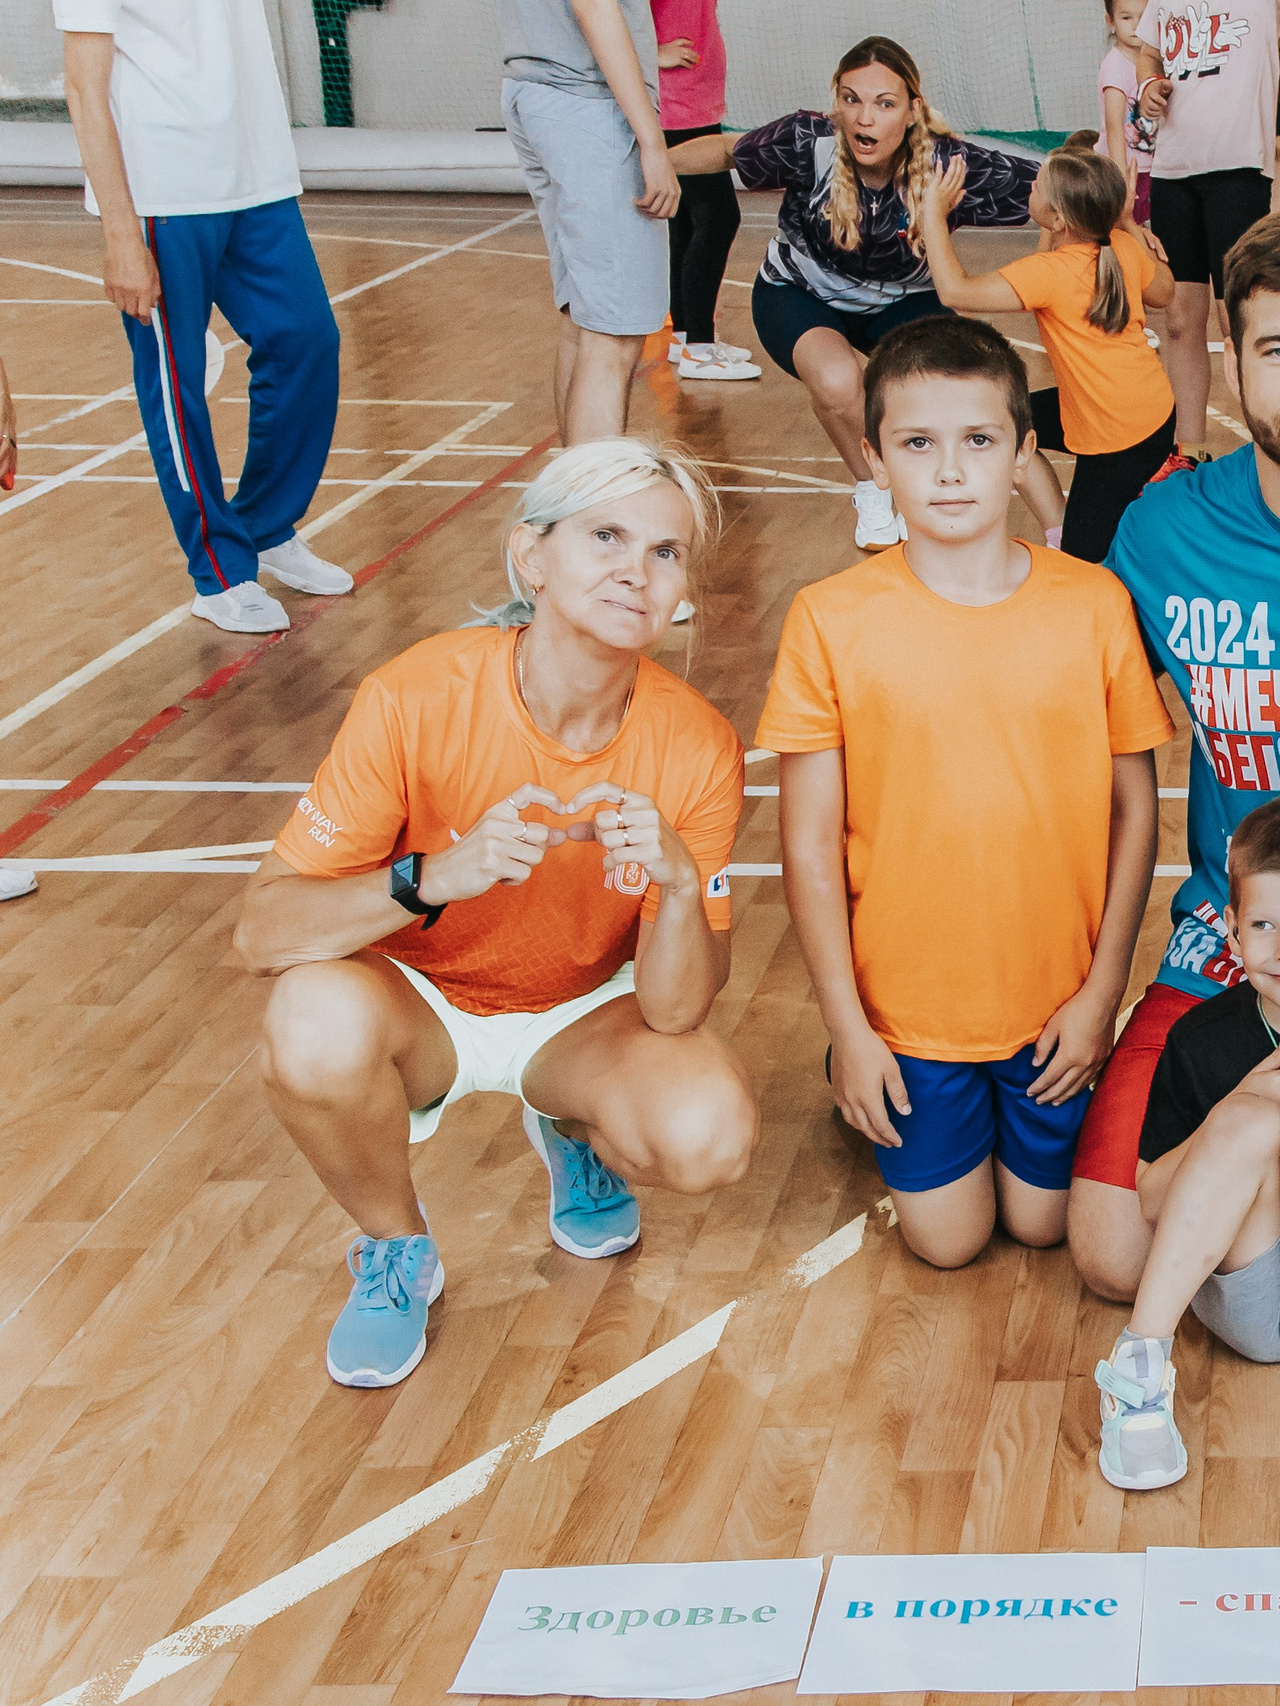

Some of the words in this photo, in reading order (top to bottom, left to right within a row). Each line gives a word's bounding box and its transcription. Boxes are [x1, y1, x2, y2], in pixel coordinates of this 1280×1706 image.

[1165, 595, 1275, 666] 2024
[307, 825, 335, 848] RUN
[518, 1604, 778, 1636] Здоровье
[844, 1600, 875, 1620] в
[894, 1597, 1120, 1625] порядке
